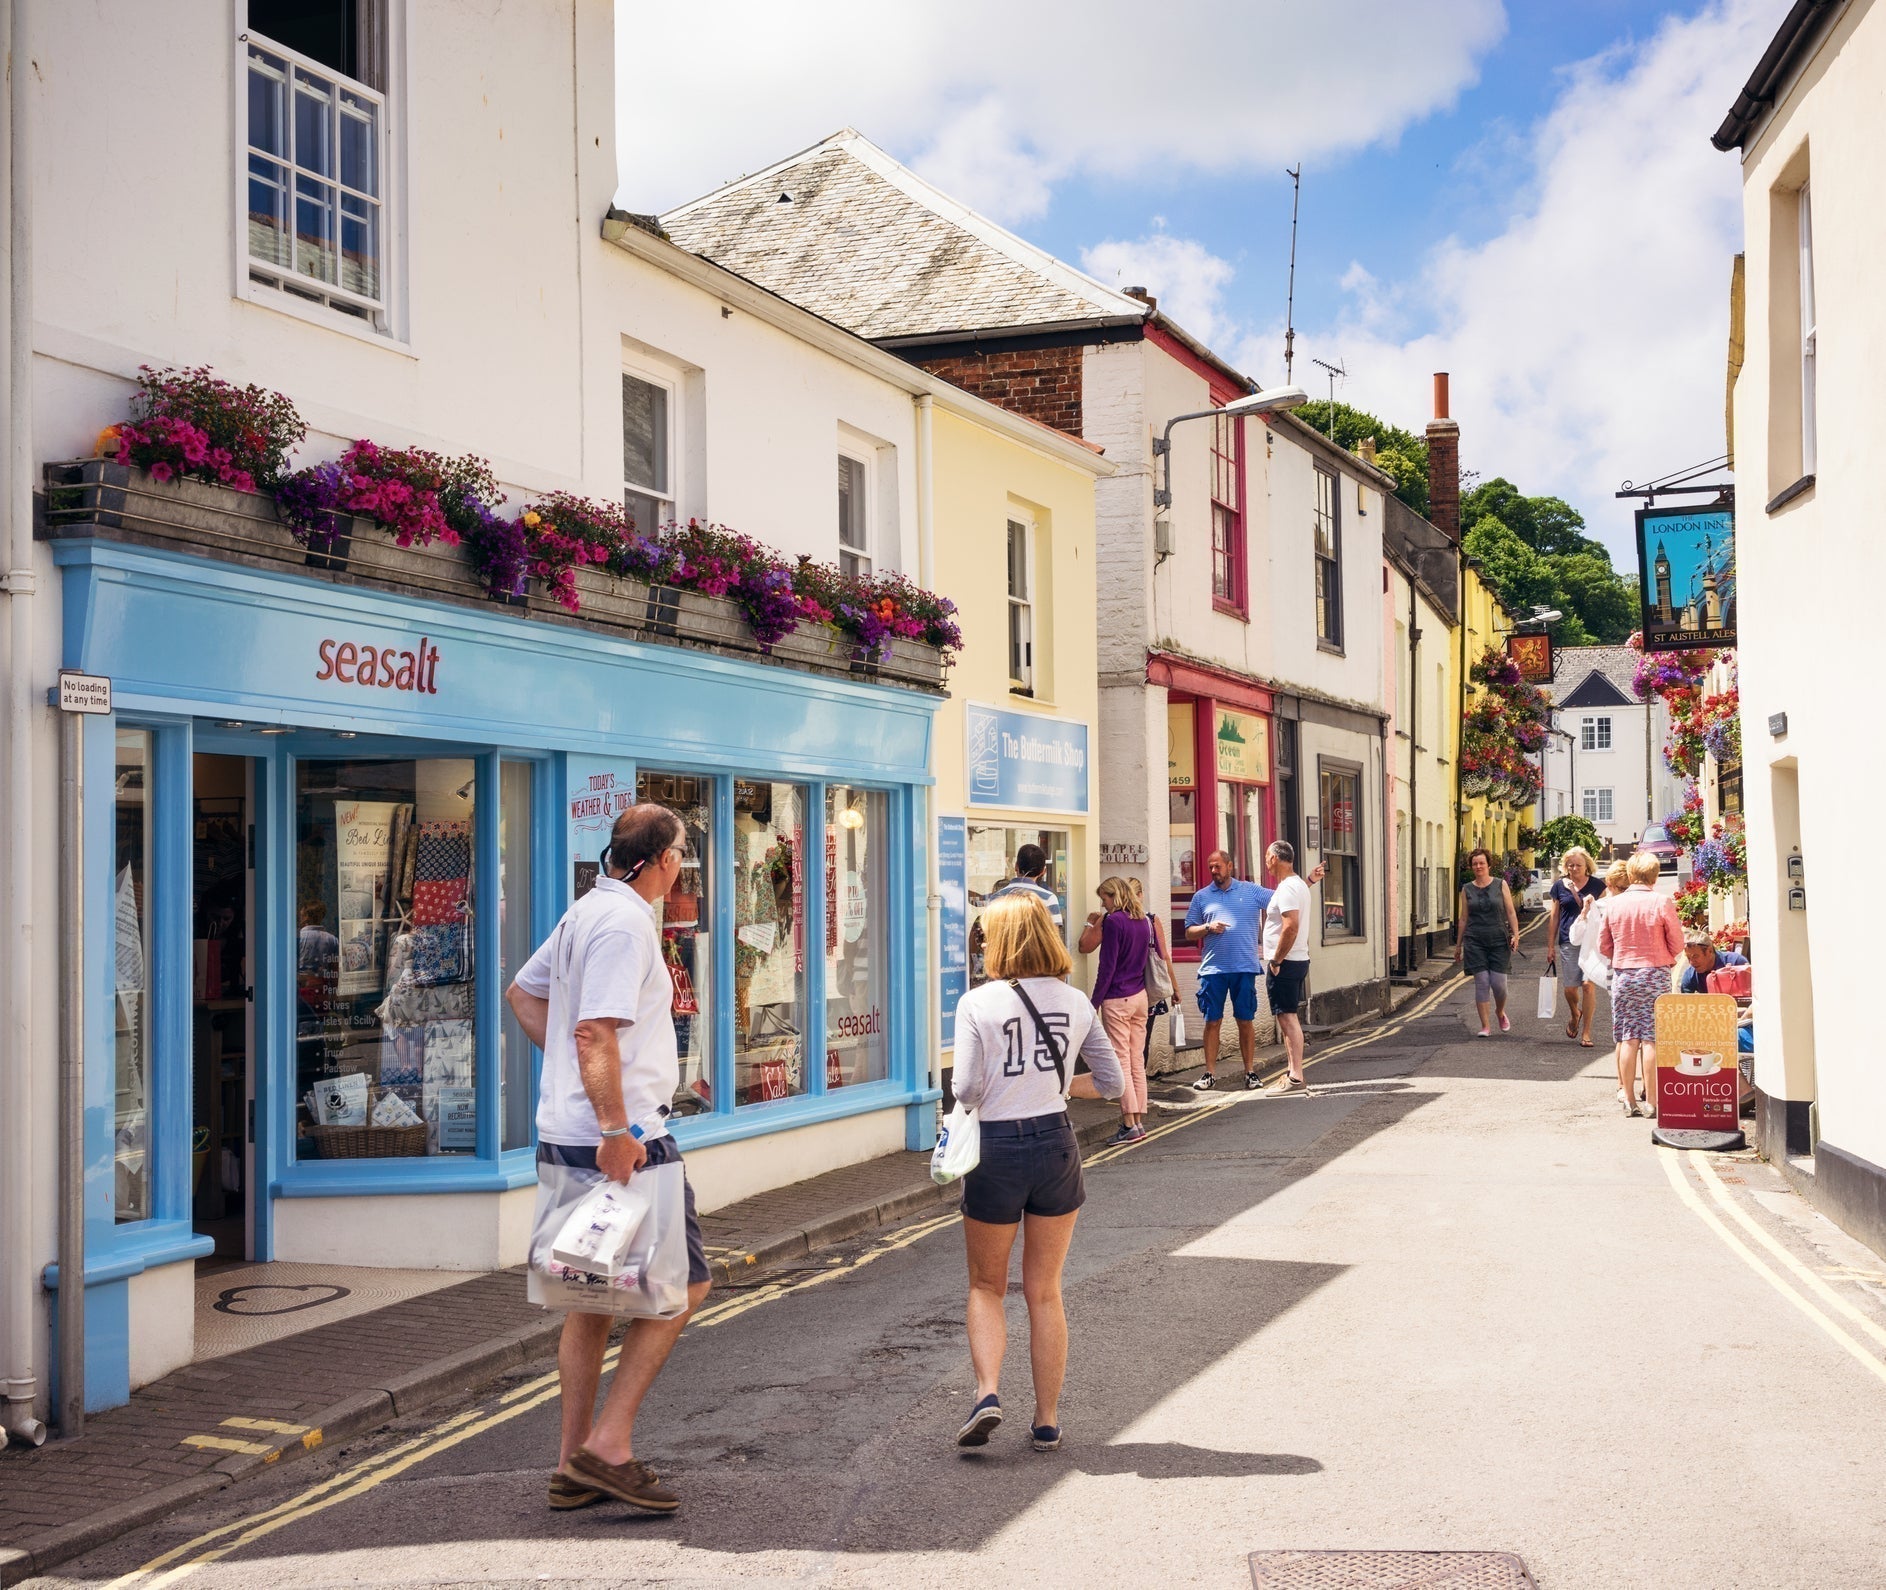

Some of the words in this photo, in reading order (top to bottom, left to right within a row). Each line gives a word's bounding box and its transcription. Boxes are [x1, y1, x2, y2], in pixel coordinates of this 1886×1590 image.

[1652, 521, 1701, 534] LONDON
[1704, 519, 1724, 530] INN
[1654, 633, 1666, 643] ST
[1669, 630, 1710, 642] AUSTELL
[1713, 629, 1736, 639] ALES
[316, 636, 440, 695] seasalt
[64, 680, 76, 691] No
[77, 681, 107, 695] loading
[63, 694, 72, 703] at
[74, 695, 88, 706] any
[90, 695, 108, 706] time
[1002, 731, 1018, 760] The
[1020, 735, 1063, 765] Buttermilk
[1064, 741, 1084, 773] Shop
[1218, 741, 1240, 758] Ocean
[589, 773, 615, 792] TODAY'S
[571, 797, 601, 819] WEATHER
[603, 791, 613, 819] &
[614, 792, 632, 811] TIDES
[340, 802, 360, 826] NEW!
[346, 828, 371, 846] Bed
[1102, 844, 1145, 854] HAPEL
[323, 1000, 331, 1010] St
[333, 1000, 350, 1010] Ives
[1656, 1003, 1736, 1014] ESPRESSO
[323, 1016, 341, 1026] Isles
[344, 1015, 352, 1025] of
[354, 1015, 376, 1027] Scilly
[837, 1004, 881, 1038] seasalt
[1656, 1012, 1693, 1020] CAFFE
[1696, 1012, 1736, 1020] LATTE
[1656, 1025, 1736, 1034] CAPPUCCINO
[323, 1047, 344, 1057] Truro
[1002, 1012, 1070, 1077] 15
[323, 1063, 358, 1073] Padstow
[827, 1059, 840, 1084] ale
[765, 1071, 787, 1100] Sale
[1663, 1079, 1733, 1097] cornico
